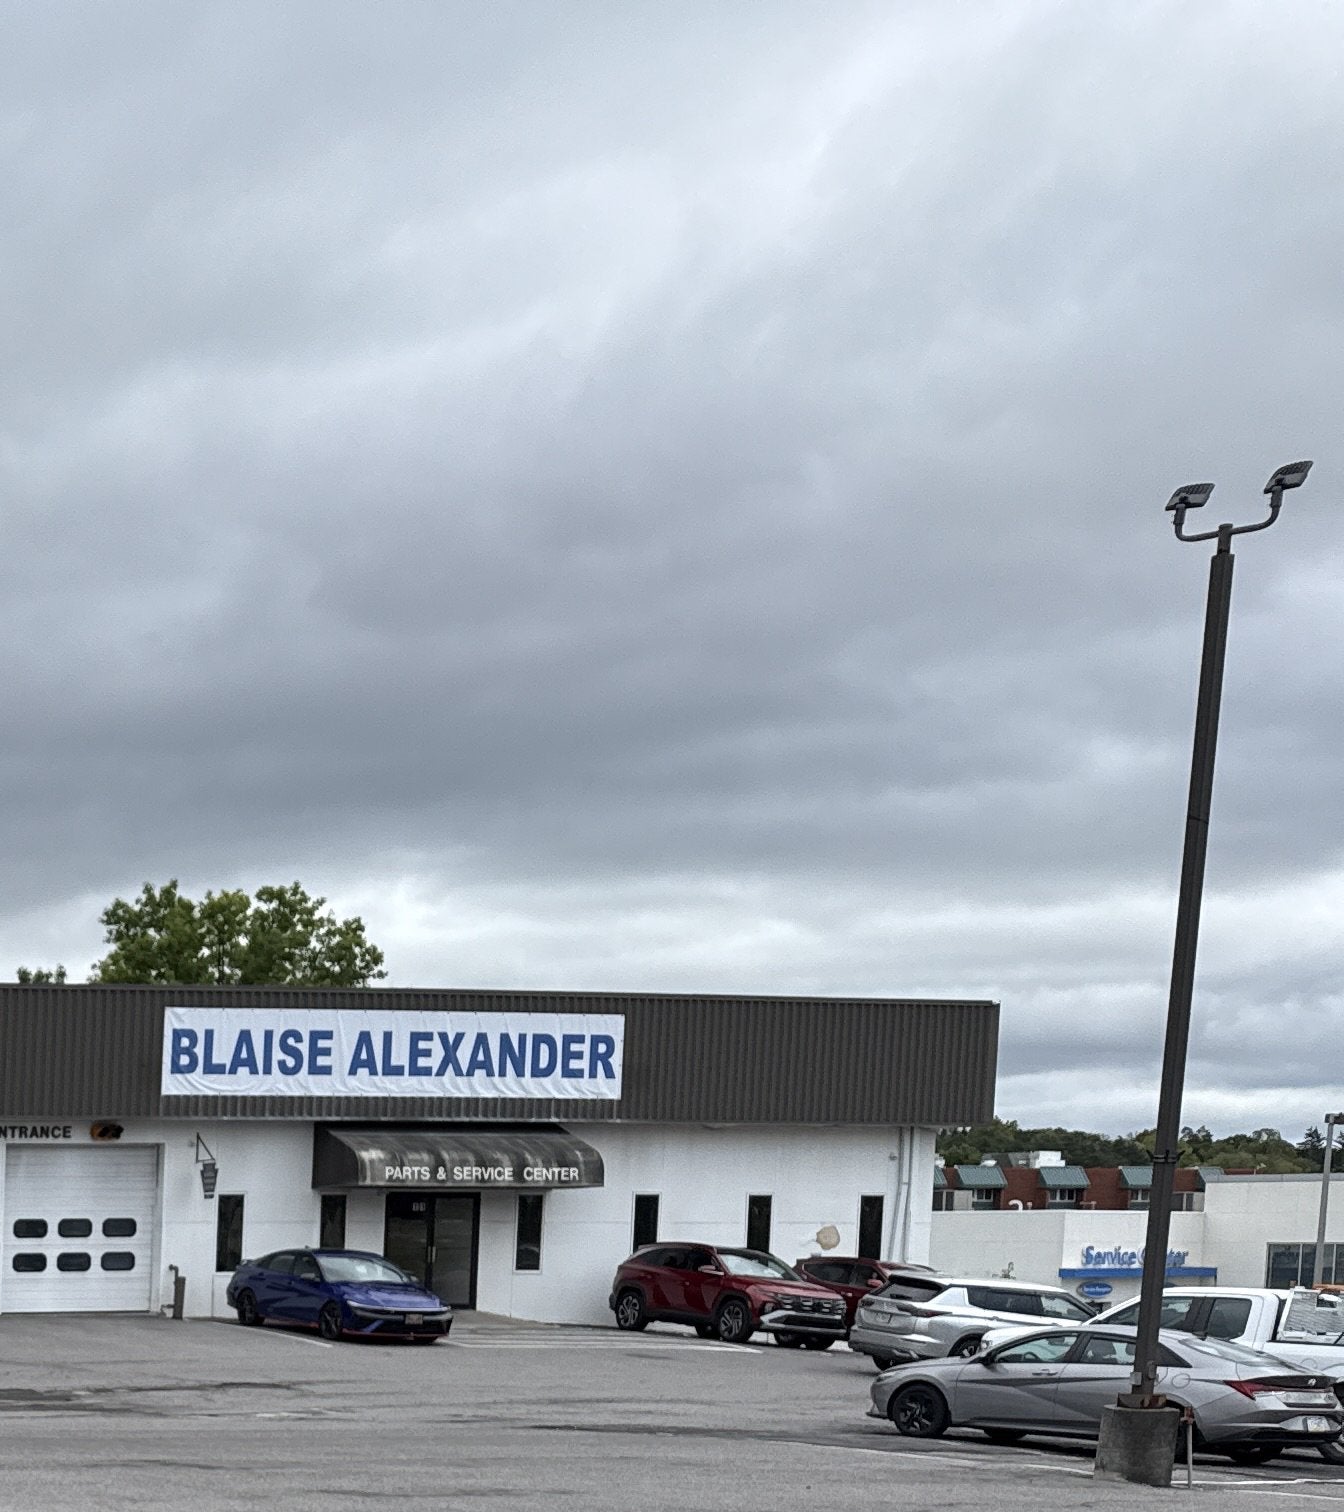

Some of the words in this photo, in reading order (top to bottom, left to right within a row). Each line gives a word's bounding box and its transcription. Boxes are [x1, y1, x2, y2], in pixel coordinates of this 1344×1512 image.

[169, 1028, 334, 1076] BLAISE
[348, 1029, 617, 1080] ALEXANDER
[385, 1166, 431, 1181] PARTS
[436, 1166, 447, 1181] &
[453, 1166, 514, 1181] SERVICE
[523, 1166, 580, 1181] CENTER
[1082, 1245, 1137, 1266] Service
[1138, 1247, 1190, 1268] Cter
